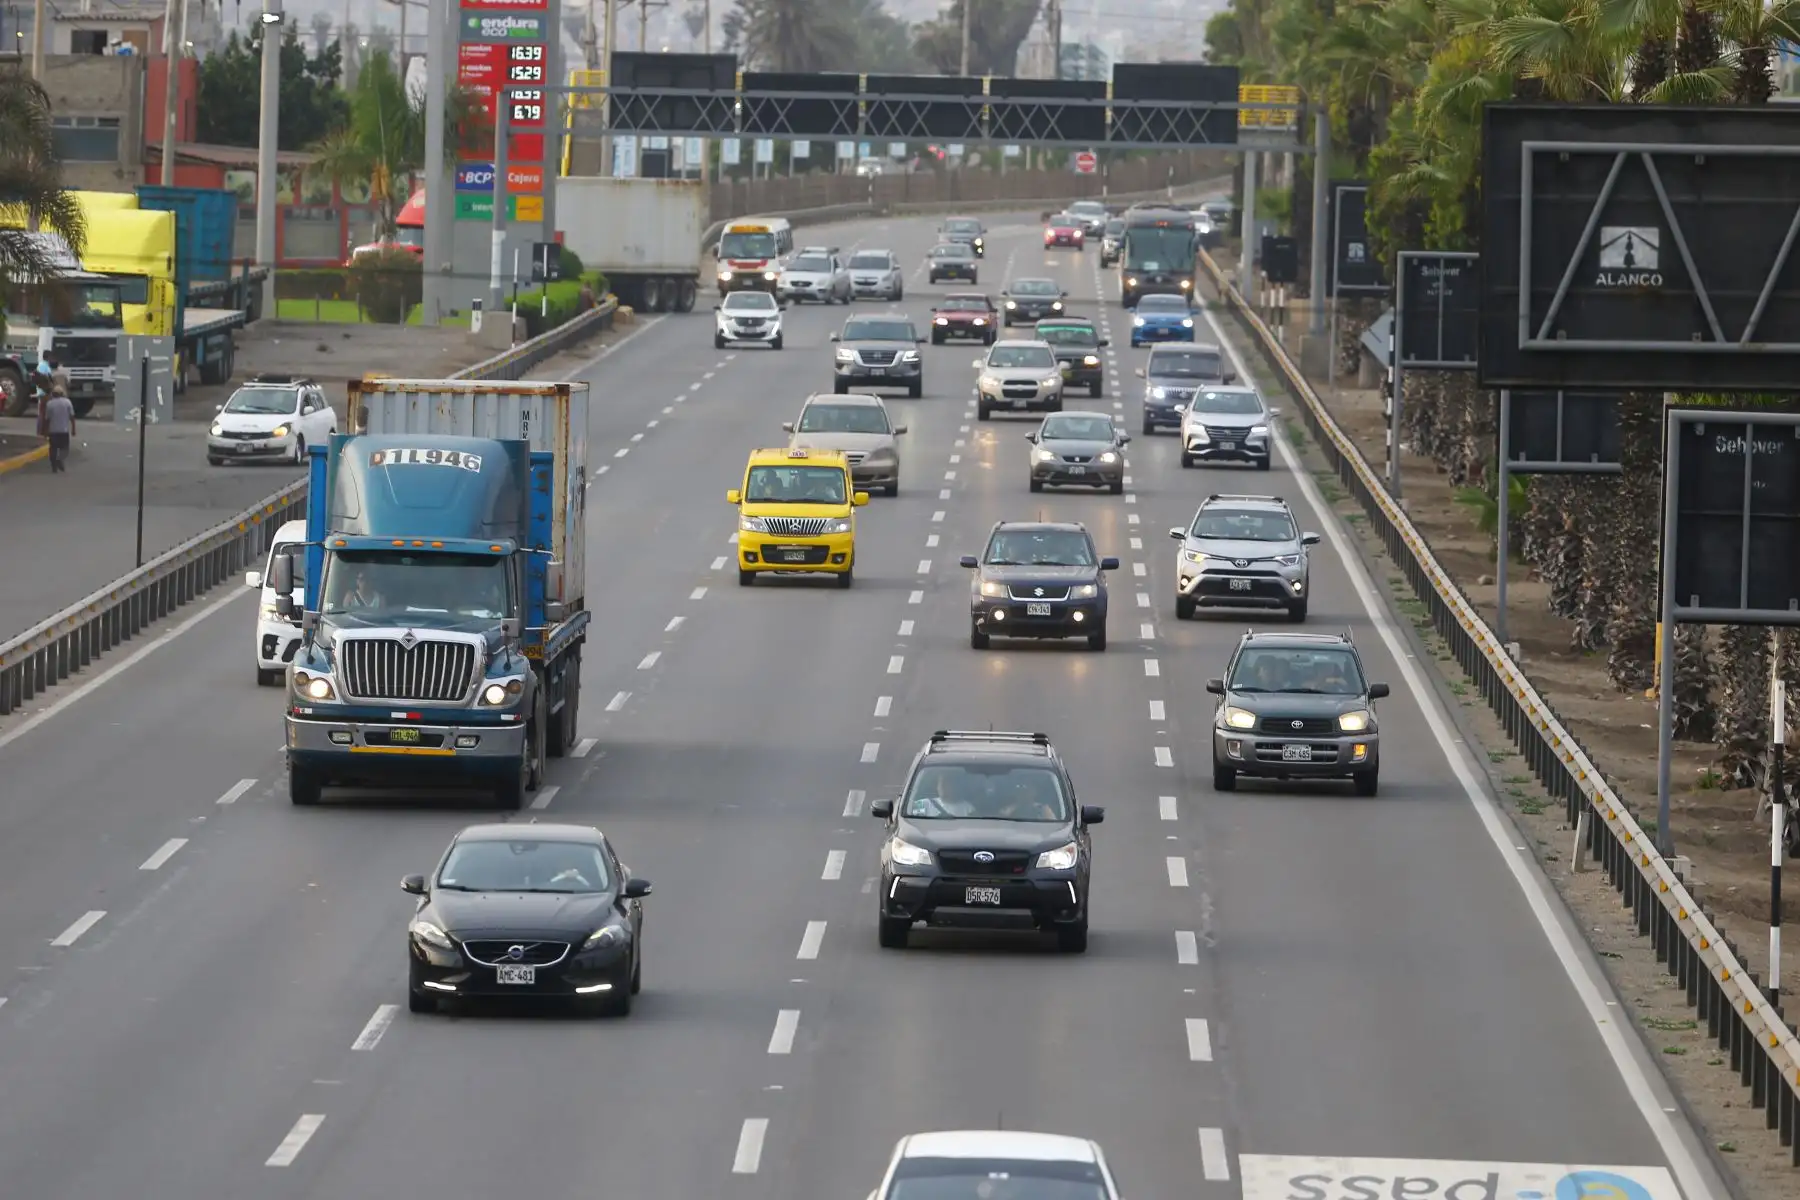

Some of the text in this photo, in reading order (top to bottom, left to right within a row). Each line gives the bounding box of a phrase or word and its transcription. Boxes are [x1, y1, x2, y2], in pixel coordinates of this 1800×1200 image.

[481, 16, 539, 29] endura
[465, 172, 492, 184] BCP
[1596, 273, 1663, 286] ALANCO
[370, 449, 480, 471] D1L946
[498, 969, 534, 982] AMC-481
